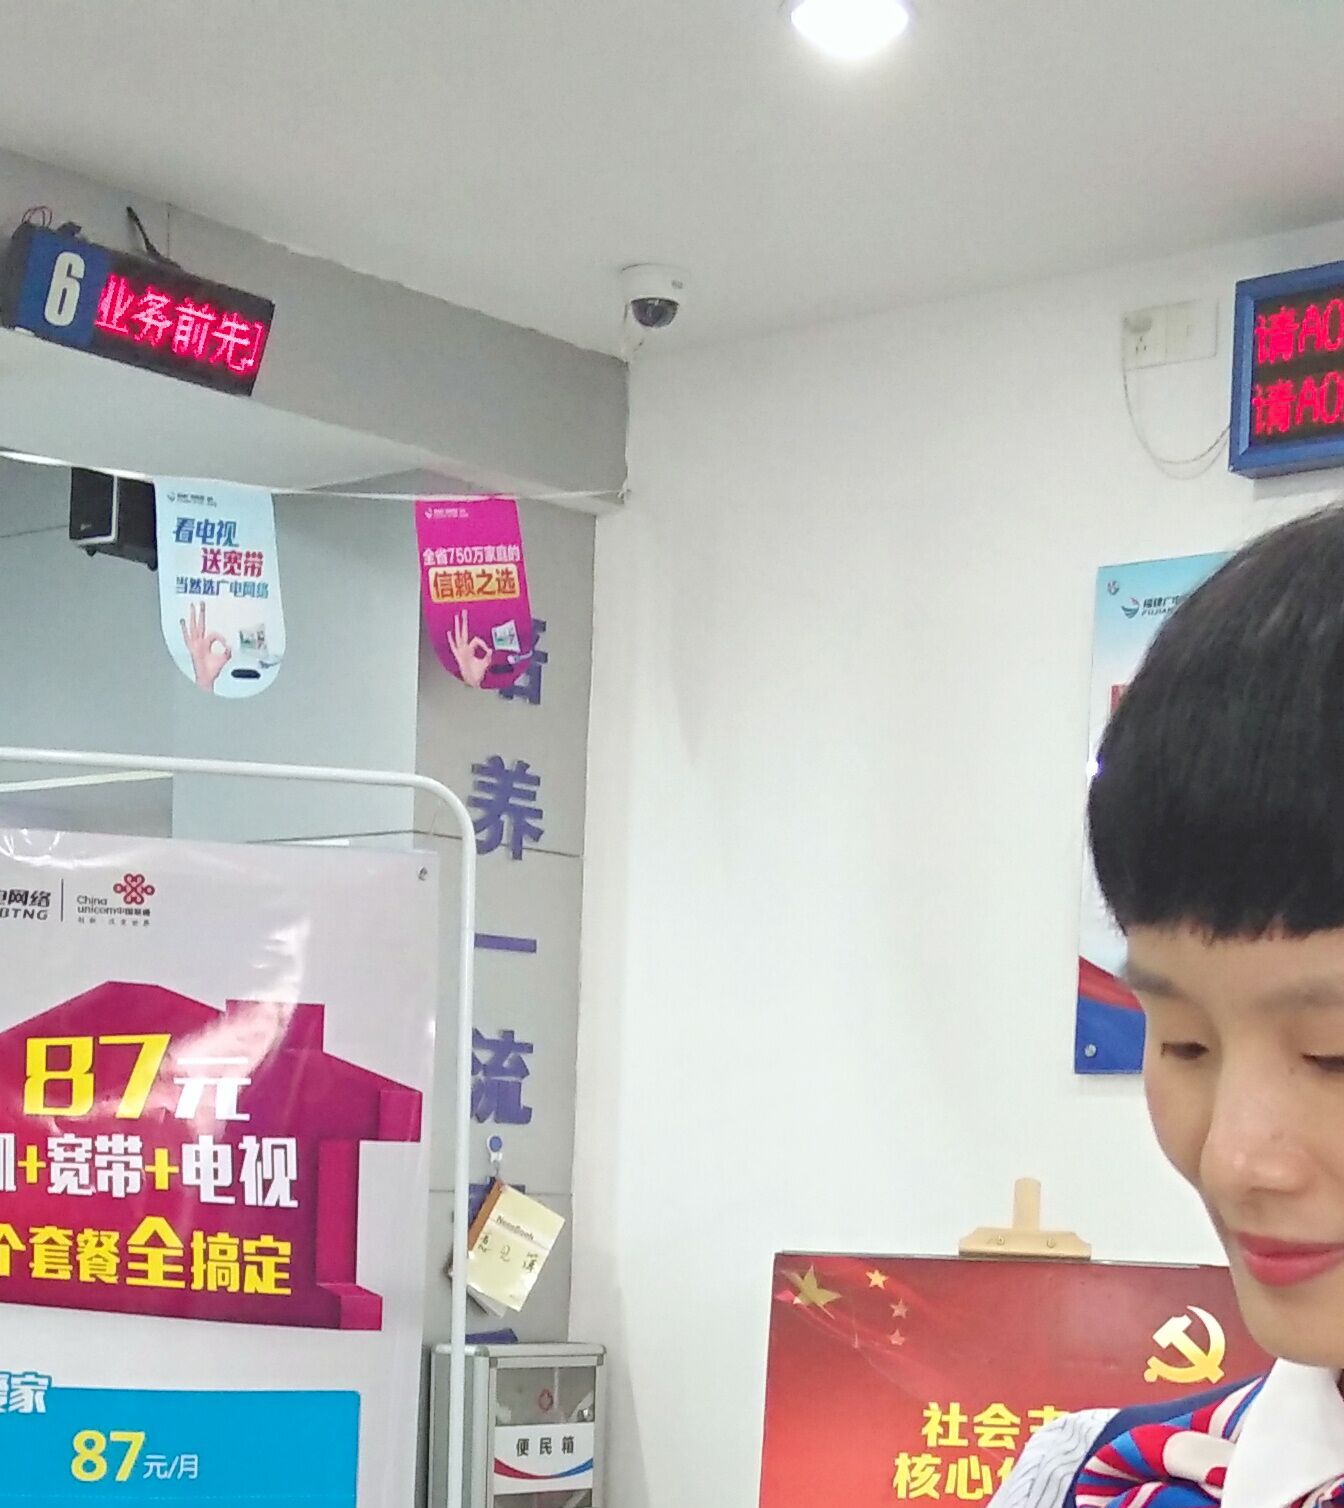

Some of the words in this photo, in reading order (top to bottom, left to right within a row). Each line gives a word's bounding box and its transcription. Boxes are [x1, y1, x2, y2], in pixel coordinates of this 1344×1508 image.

[44, 251, 86, 327] 6
[94, 272, 264, 374] 业务前先
[173, 517, 239, 548] 看电视
[201, 547, 263, 577] 送宽带
[423, 545, 521, 567] 全省750万家庭的
[176, 577, 269, 599] 当然选广电网络
[433, 569, 516, 599] 信赖之选
[0, 907, 49, 921] BTNG
[76, 894, 108, 907] China
[22, 1033, 252, 1122] 87元
[70, 1429, 200, 1482] 87元/月
[516, 1435, 575, 1457] 便民箱
[892, 1451, 1014, 1501] 核心
